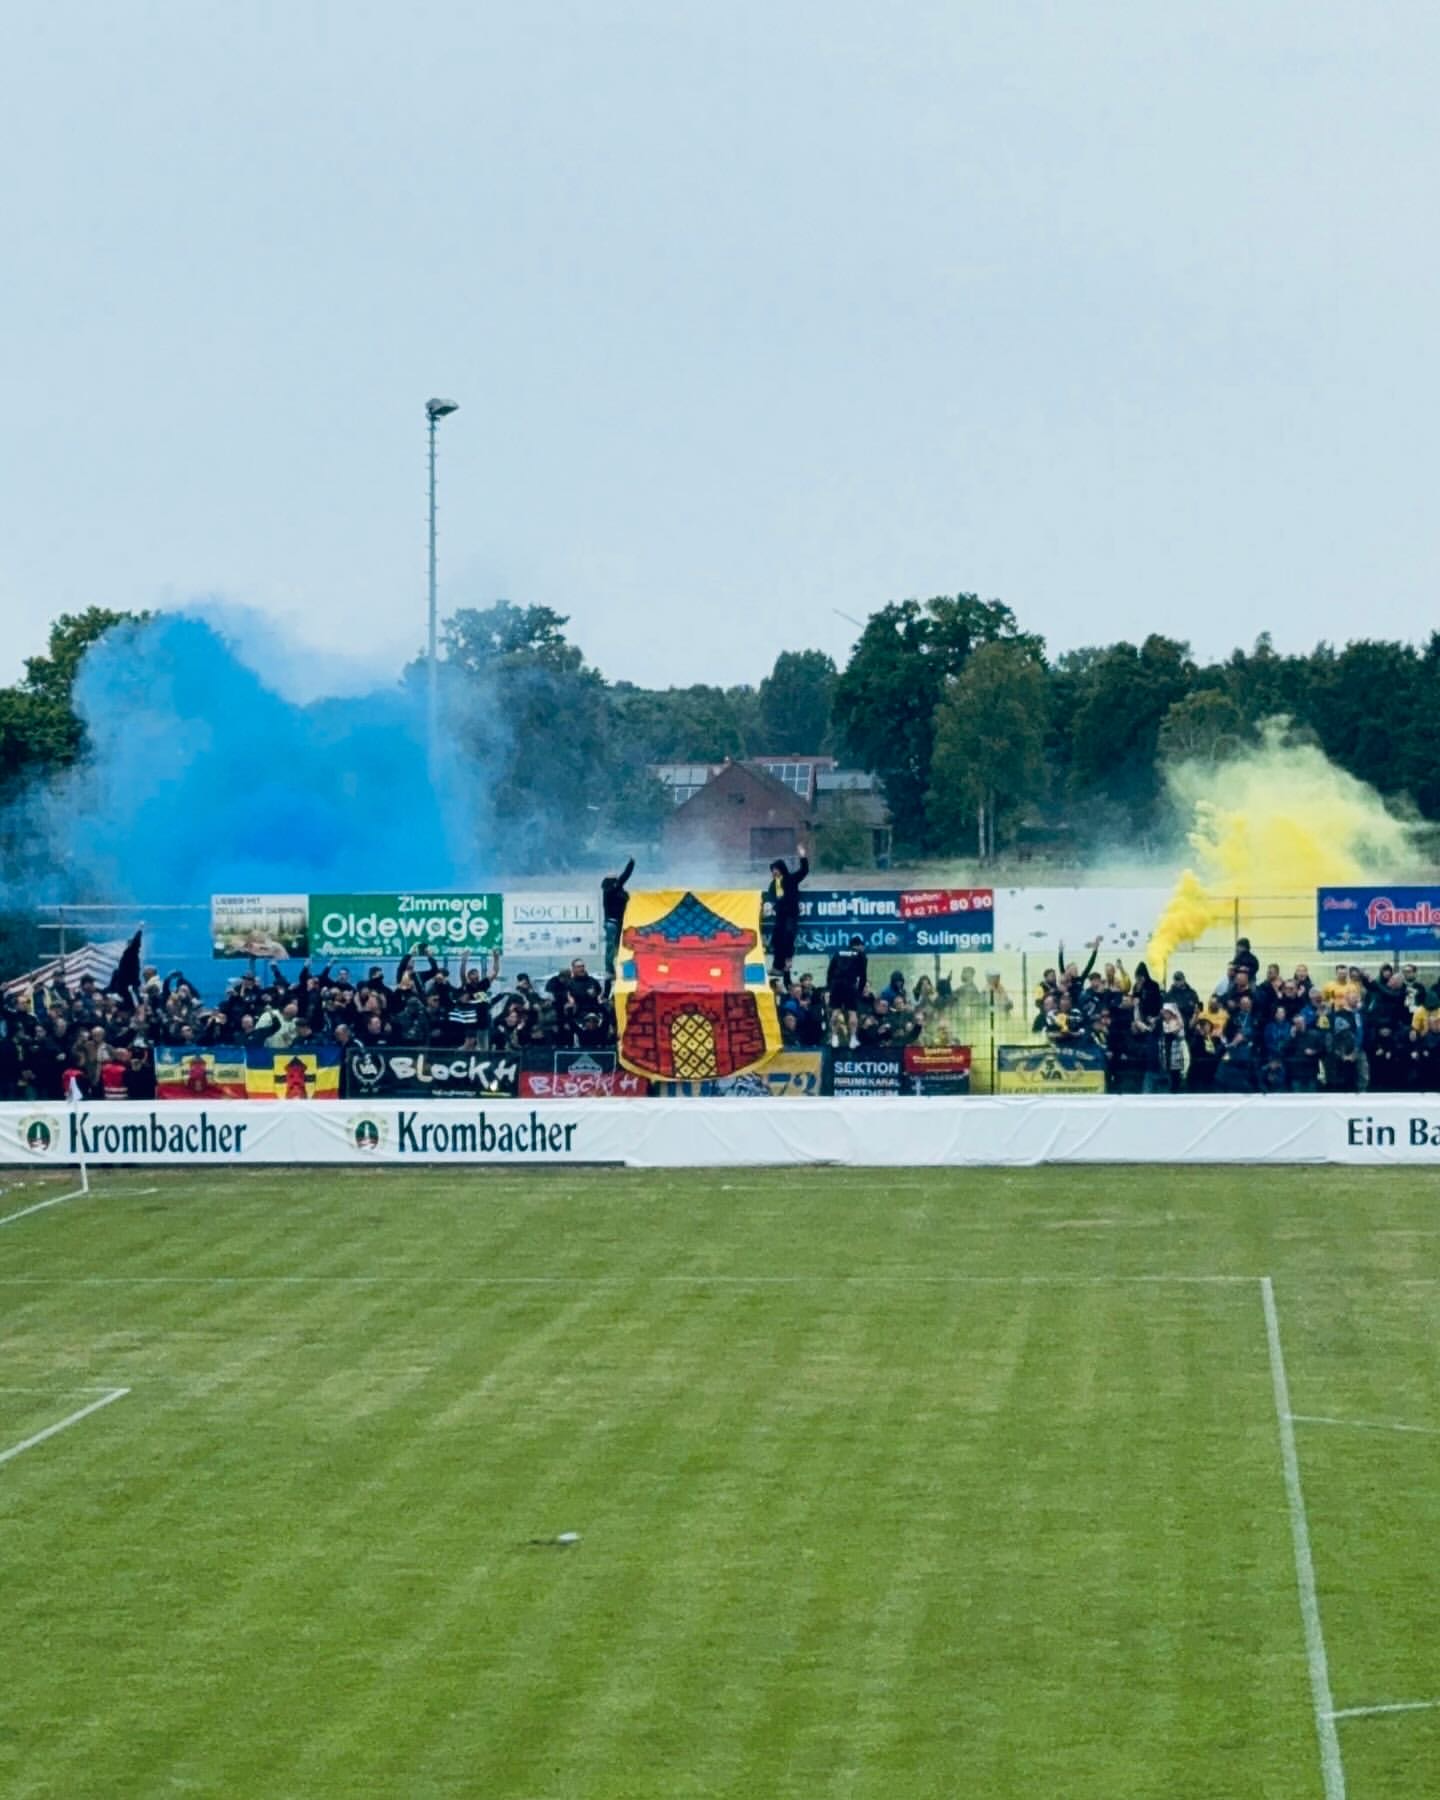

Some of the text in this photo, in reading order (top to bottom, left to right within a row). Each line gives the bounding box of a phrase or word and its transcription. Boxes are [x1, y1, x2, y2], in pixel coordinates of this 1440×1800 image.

[818, 899, 847, 915] und
[322, 913, 489, 942] Oldewage
[917, 930, 993, 949] Sulingen
[833, 1061, 900, 1075] SEKTION
[69, 1111, 248, 1153] Krombacher
[397, 1110, 578, 1153] Krombacher
[1347, 1116, 1396, 1146] Ein
